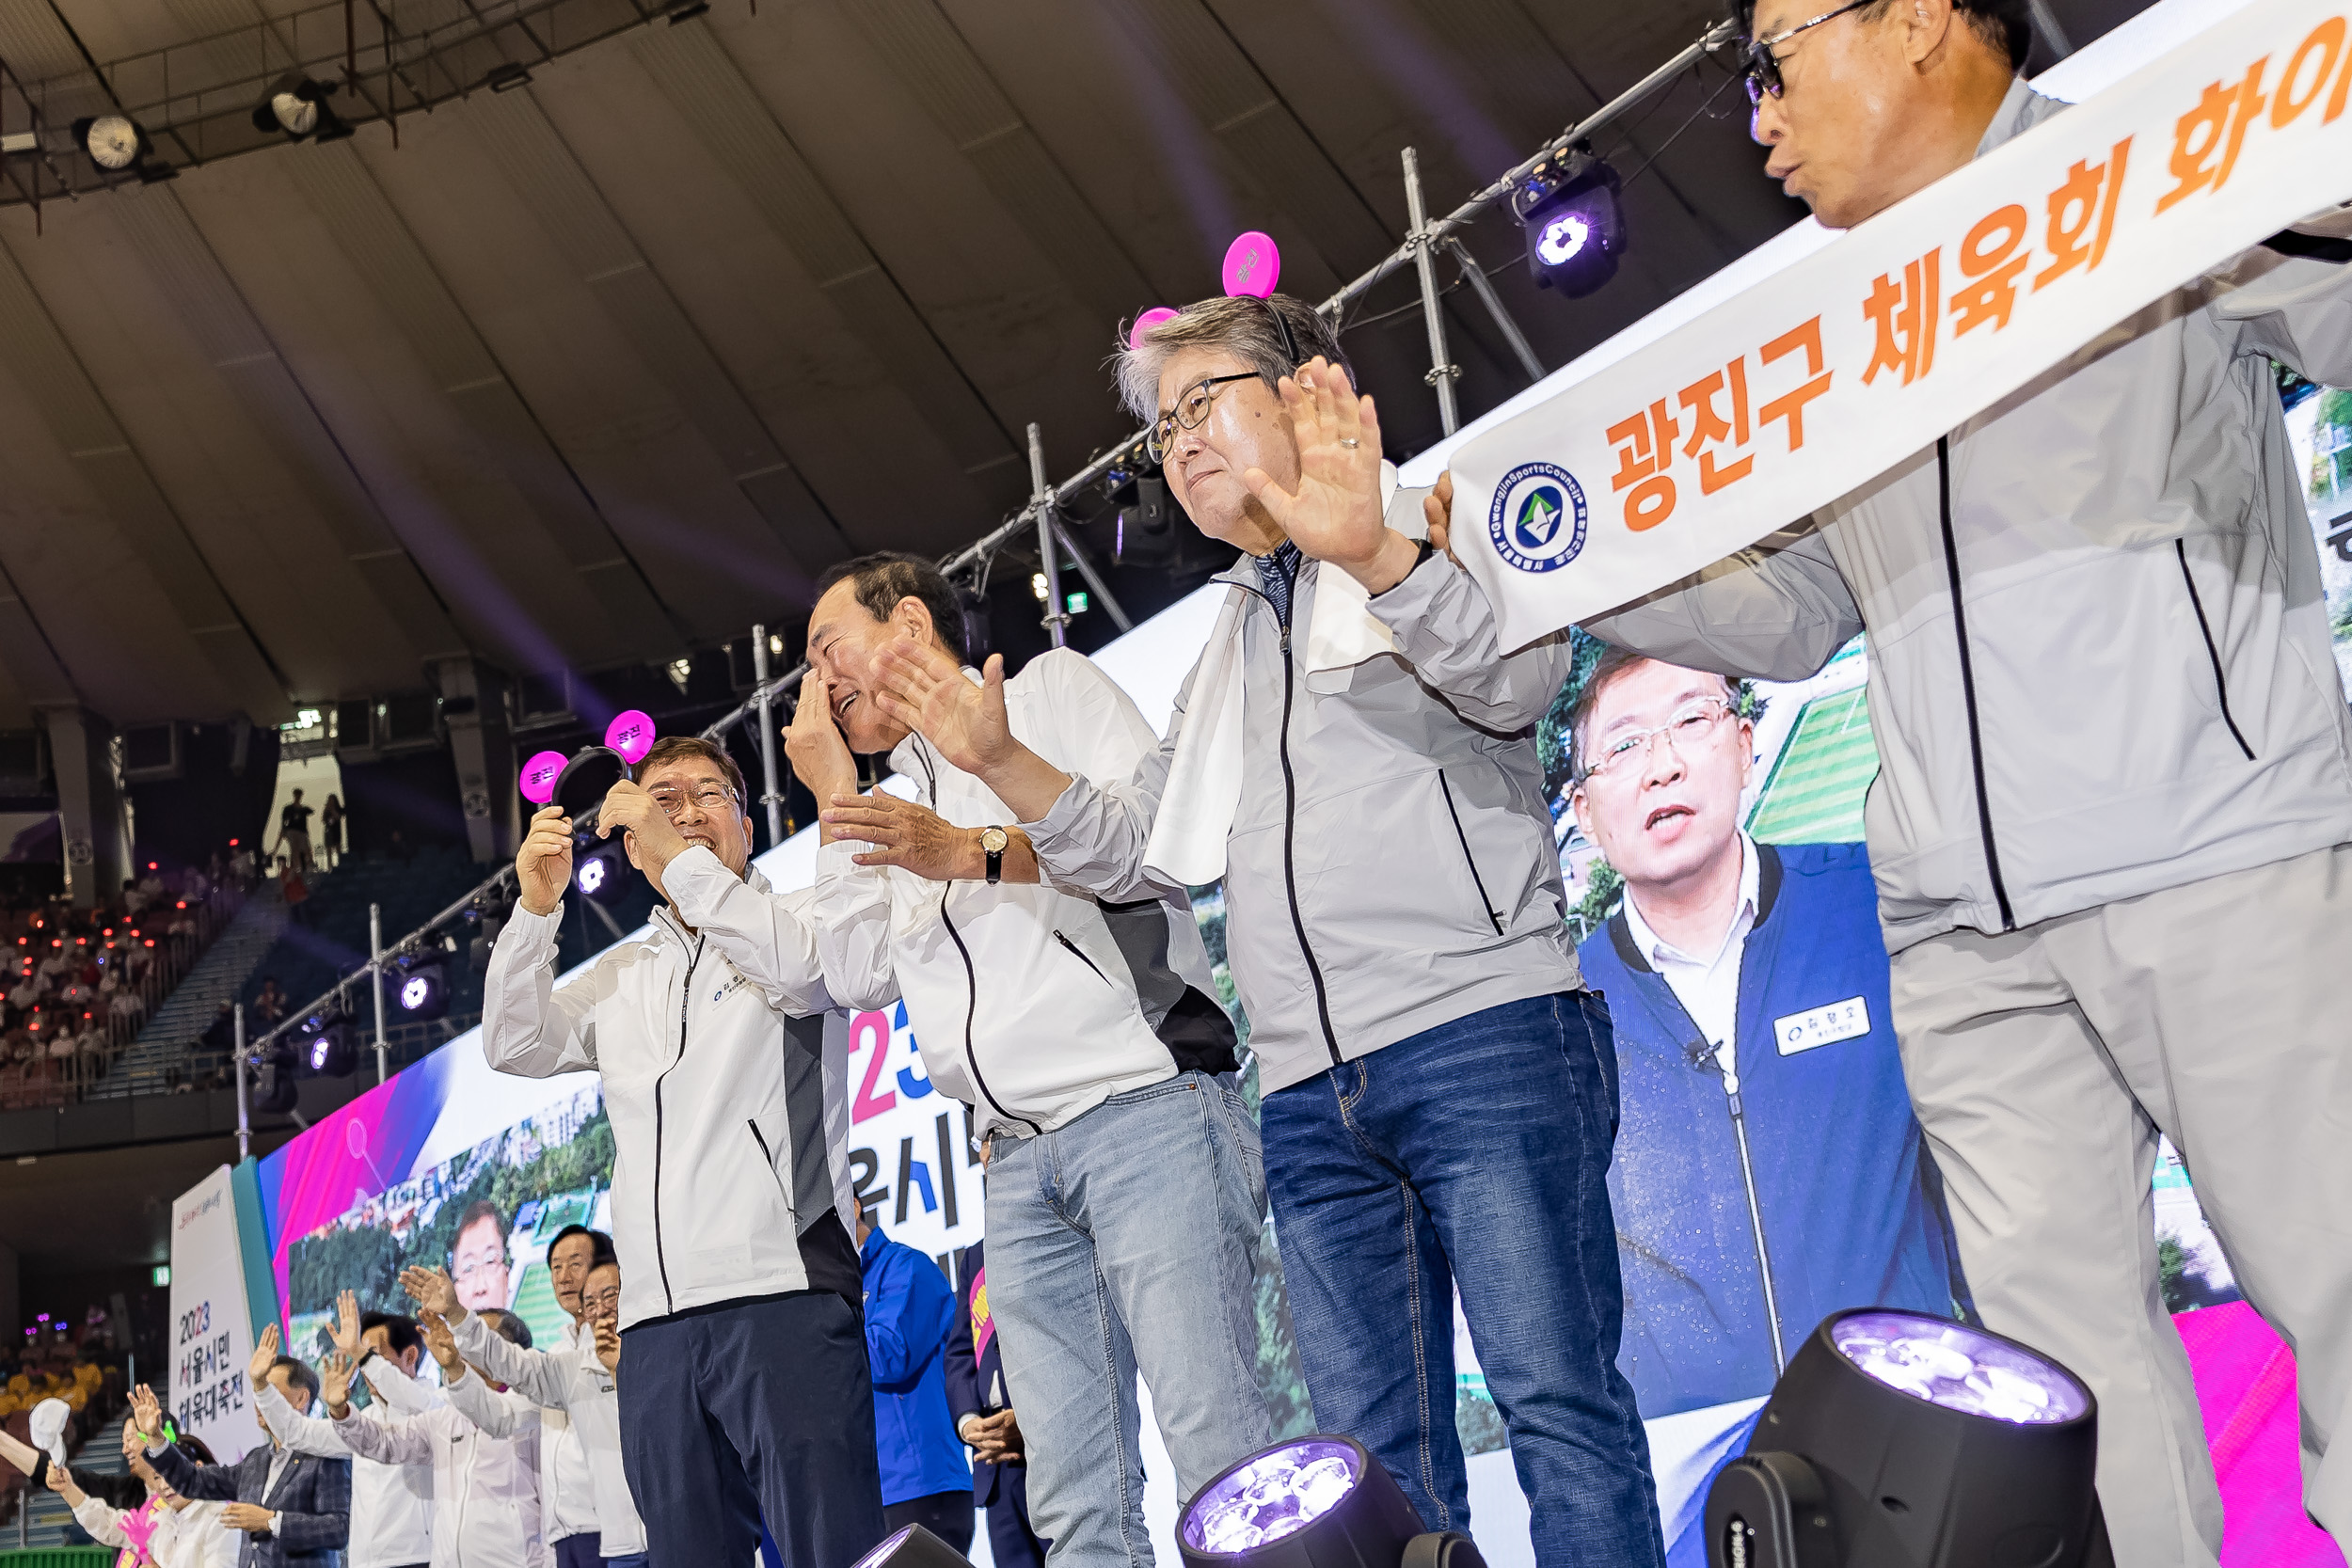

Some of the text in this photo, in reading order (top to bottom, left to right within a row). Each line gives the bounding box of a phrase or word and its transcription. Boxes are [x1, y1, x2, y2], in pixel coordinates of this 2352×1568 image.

[1605, 314, 1834, 532] 광진구
[1862, 133, 2134, 388] 체육회
[179, 1300, 211, 1346] 2023
[179, 1329, 230, 1389] 서울시민
[178, 1370, 244, 1435] 체육대축전
